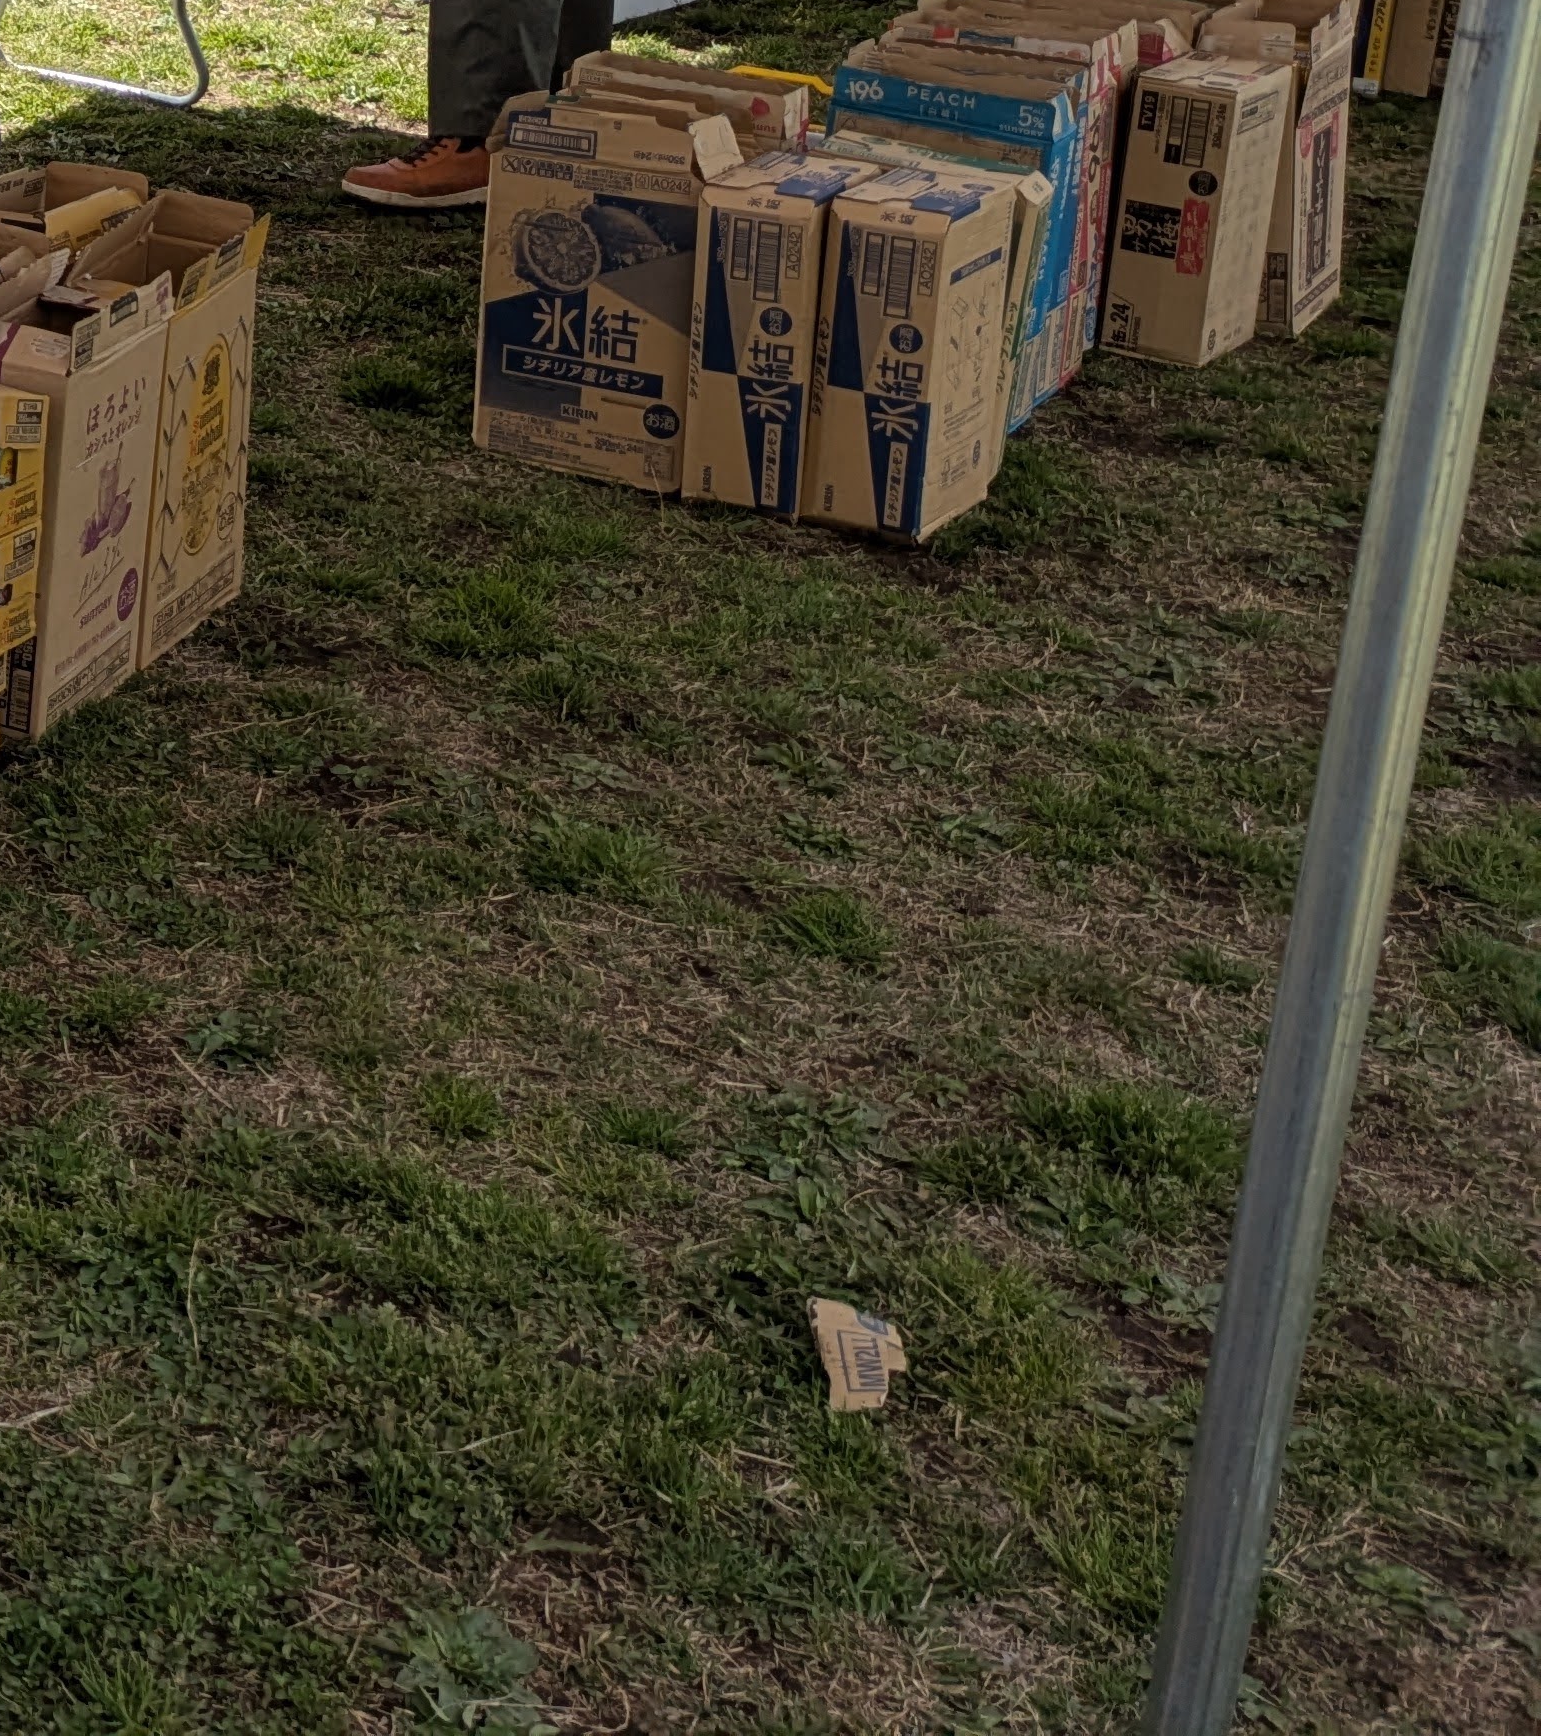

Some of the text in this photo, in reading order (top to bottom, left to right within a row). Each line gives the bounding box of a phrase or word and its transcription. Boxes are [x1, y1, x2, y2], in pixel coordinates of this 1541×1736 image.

[846, 80, 884, 103] -196
[906, 85, 976, 110] PEACH
[1018, 104, 1045, 130] 5%
[1140, 94, 1156, 126] TV19
[998, 123, 1044, 137] SUNTORY
[532, 297, 640, 363] 氷結
[523, 356, 644, 390] シチリア産レモン
[745, 338, 794, 422] 氷結
[86, 376, 147, 435] ほろよい
[562, 404, 598, 421] KIRIN
[871, 356, 923, 441] 氷結
[85, 404, 143, 459] カシスとオレンジ
[646, 414, 676, 432] お酒
[764, 427, 778, 502] シチリア産レモン
[885, 446, 903, 525] シチリア産レモン
[78, 594, 114, 630] SUNTORY
